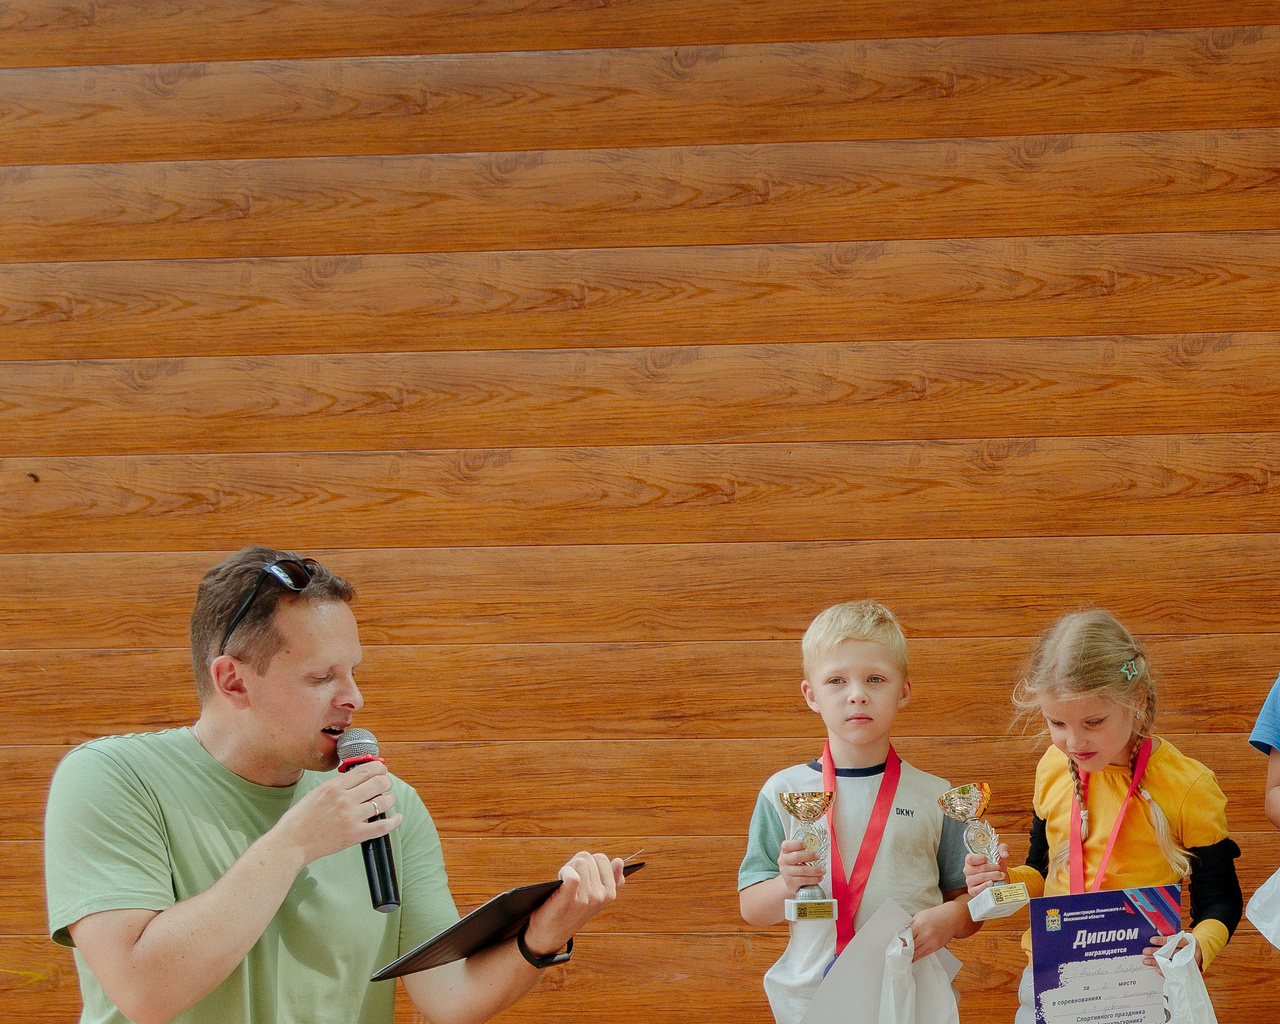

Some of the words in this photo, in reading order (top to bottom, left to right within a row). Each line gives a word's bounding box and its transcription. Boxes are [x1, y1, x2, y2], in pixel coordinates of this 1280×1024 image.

[896, 807, 915, 818] DKNY
[1073, 927, 1139, 949] Диплом
[1084, 947, 1127, 958] награждается
[1057, 994, 1102, 1006] соревнованиях
[1076, 1014, 1113, 1023] Спортивного
[1114, 1009, 1146, 1020] праздника
